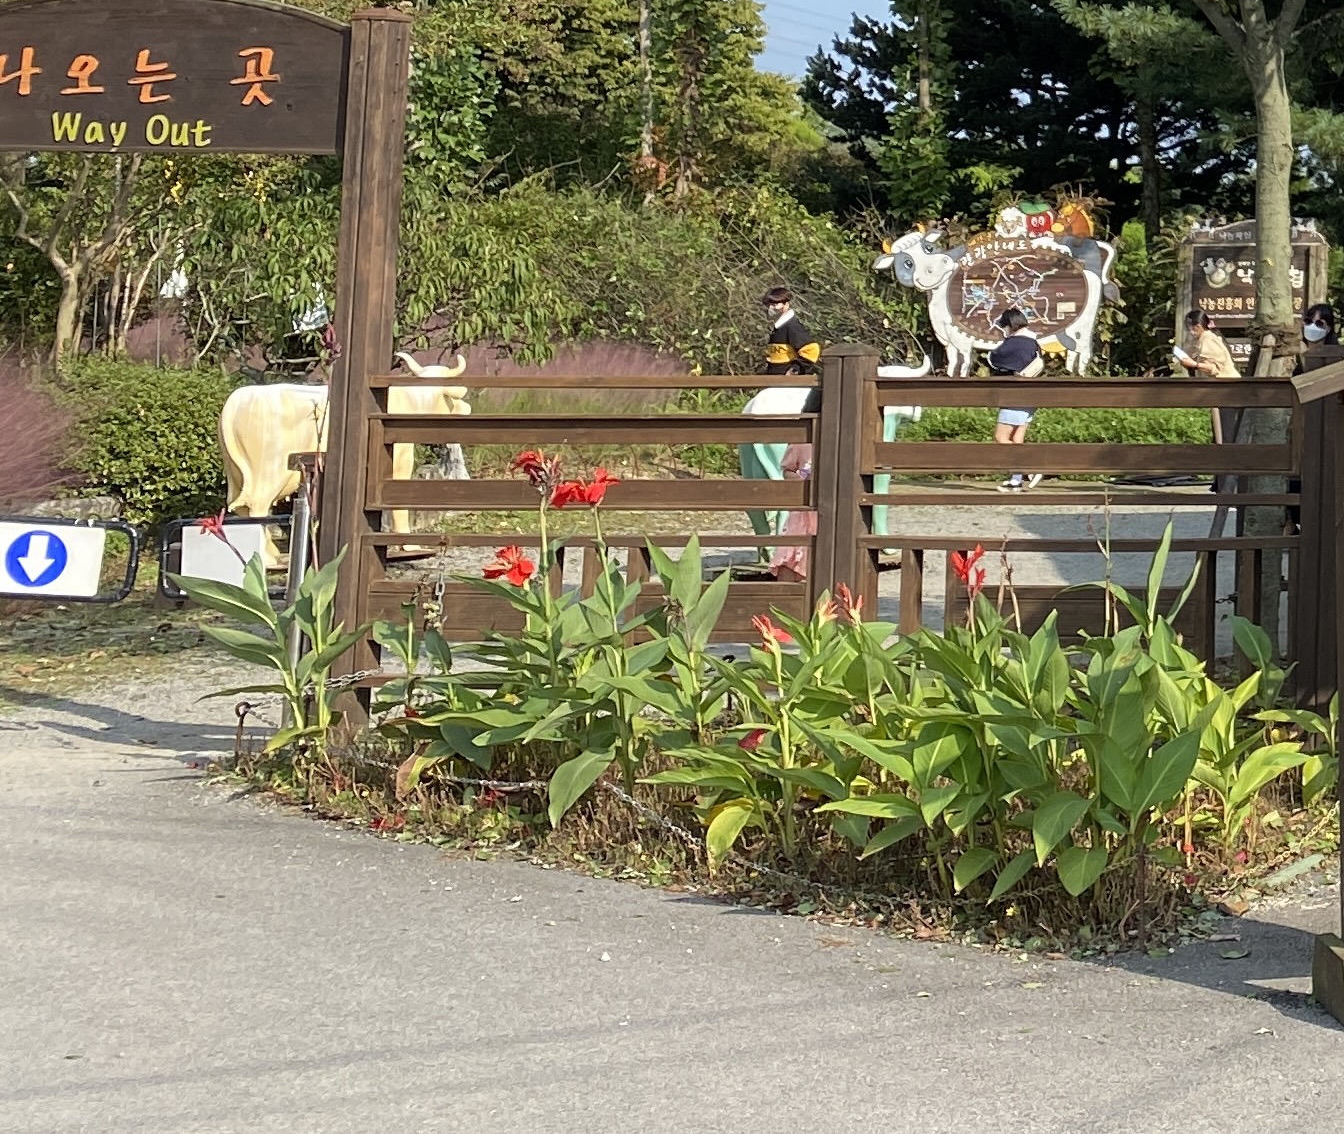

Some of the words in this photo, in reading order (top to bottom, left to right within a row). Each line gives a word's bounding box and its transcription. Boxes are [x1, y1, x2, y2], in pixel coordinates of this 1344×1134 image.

[0, 46, 178, 104] 나오는
[229, 46, 281, 106] 곳
[51, 111, 127, 152] Way
[145, 114, 212, 147] Out
[960, 239, 1028, 267] 관광안내도
[1199, 297, 1243, 311] 낙농진흥회
